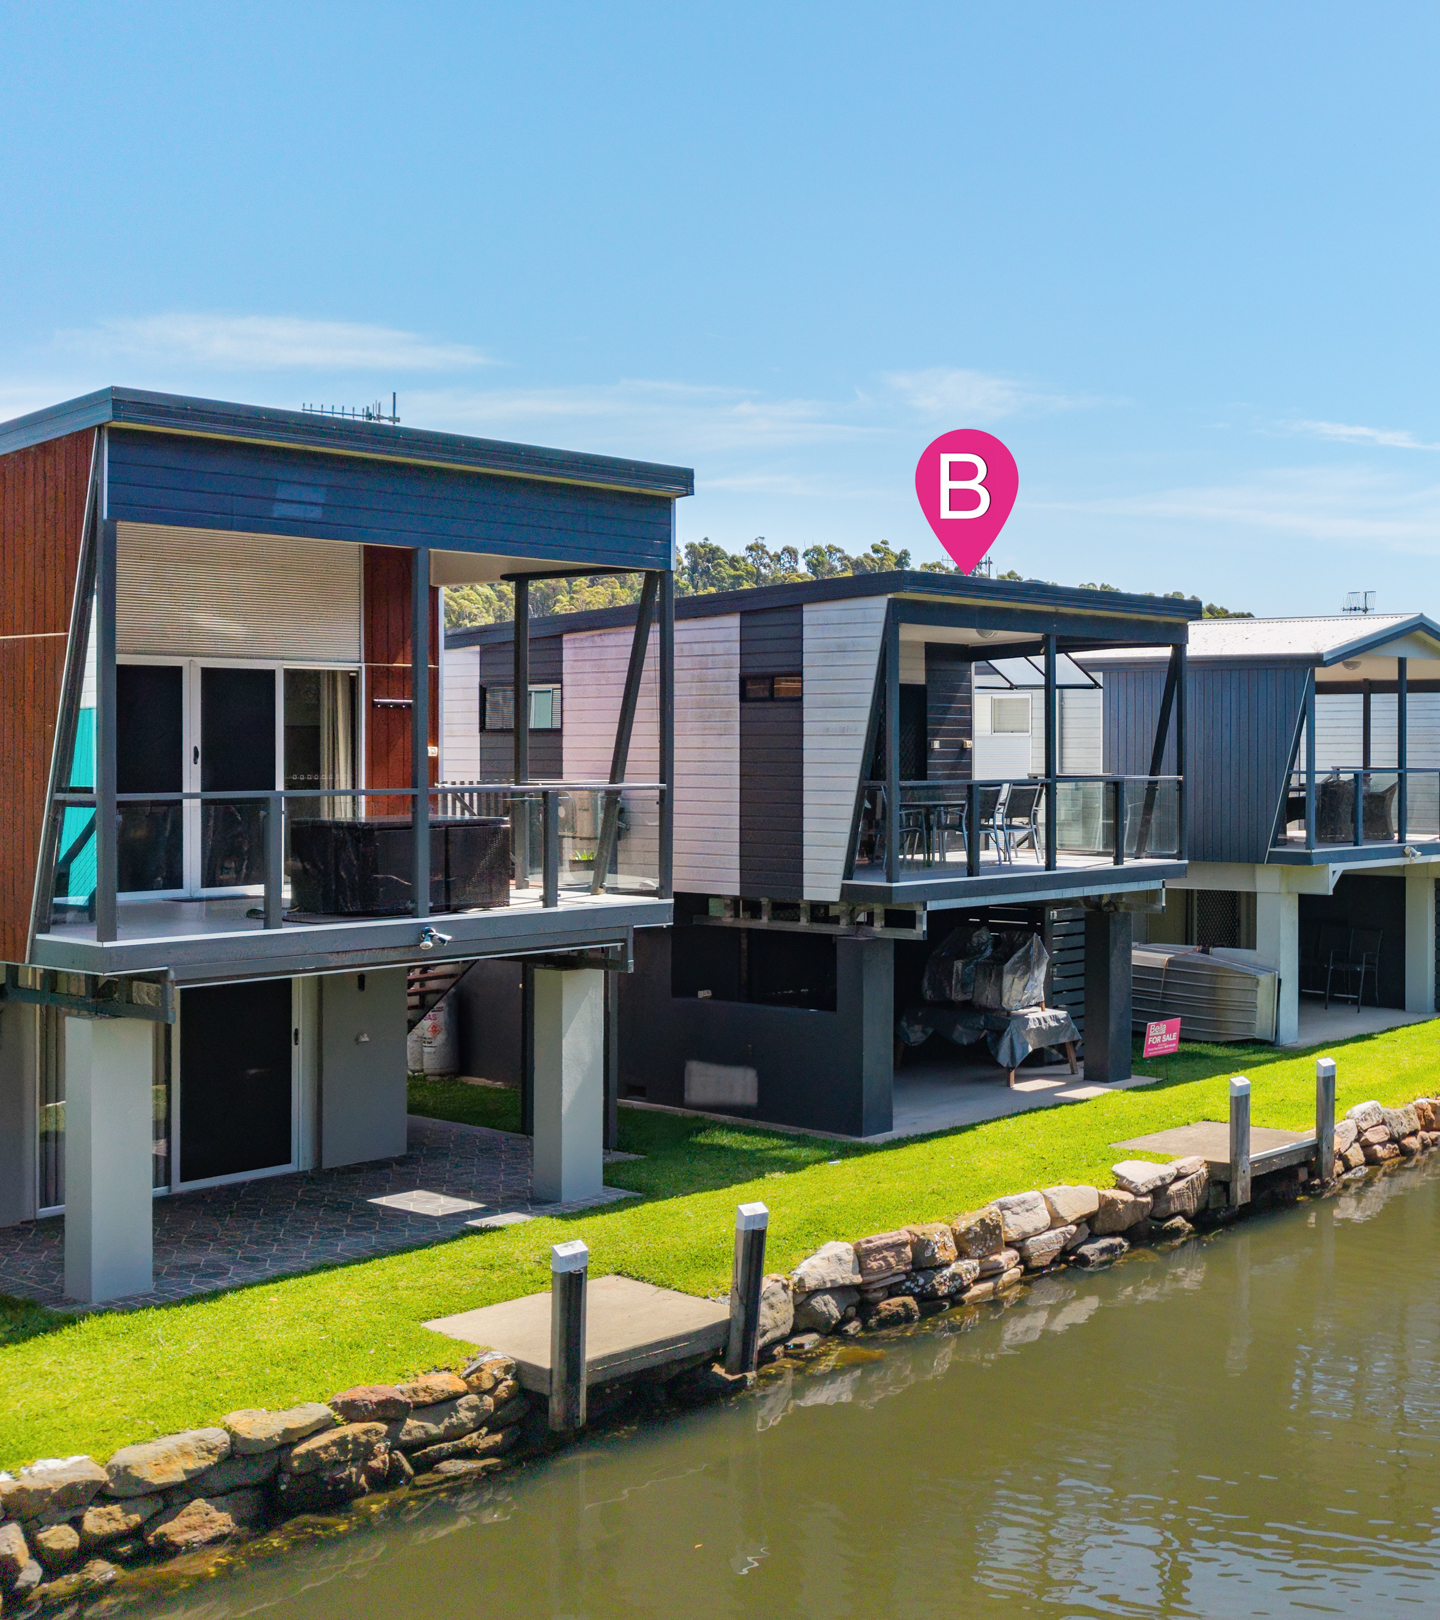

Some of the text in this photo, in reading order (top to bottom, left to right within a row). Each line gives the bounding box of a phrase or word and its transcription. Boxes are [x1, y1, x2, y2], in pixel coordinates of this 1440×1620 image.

[1150, 1023, 1167, 1033] Bella
[1148, 1036, 1161, 1045] FOR
[1162, 1033, 1177, 1042] SALE
